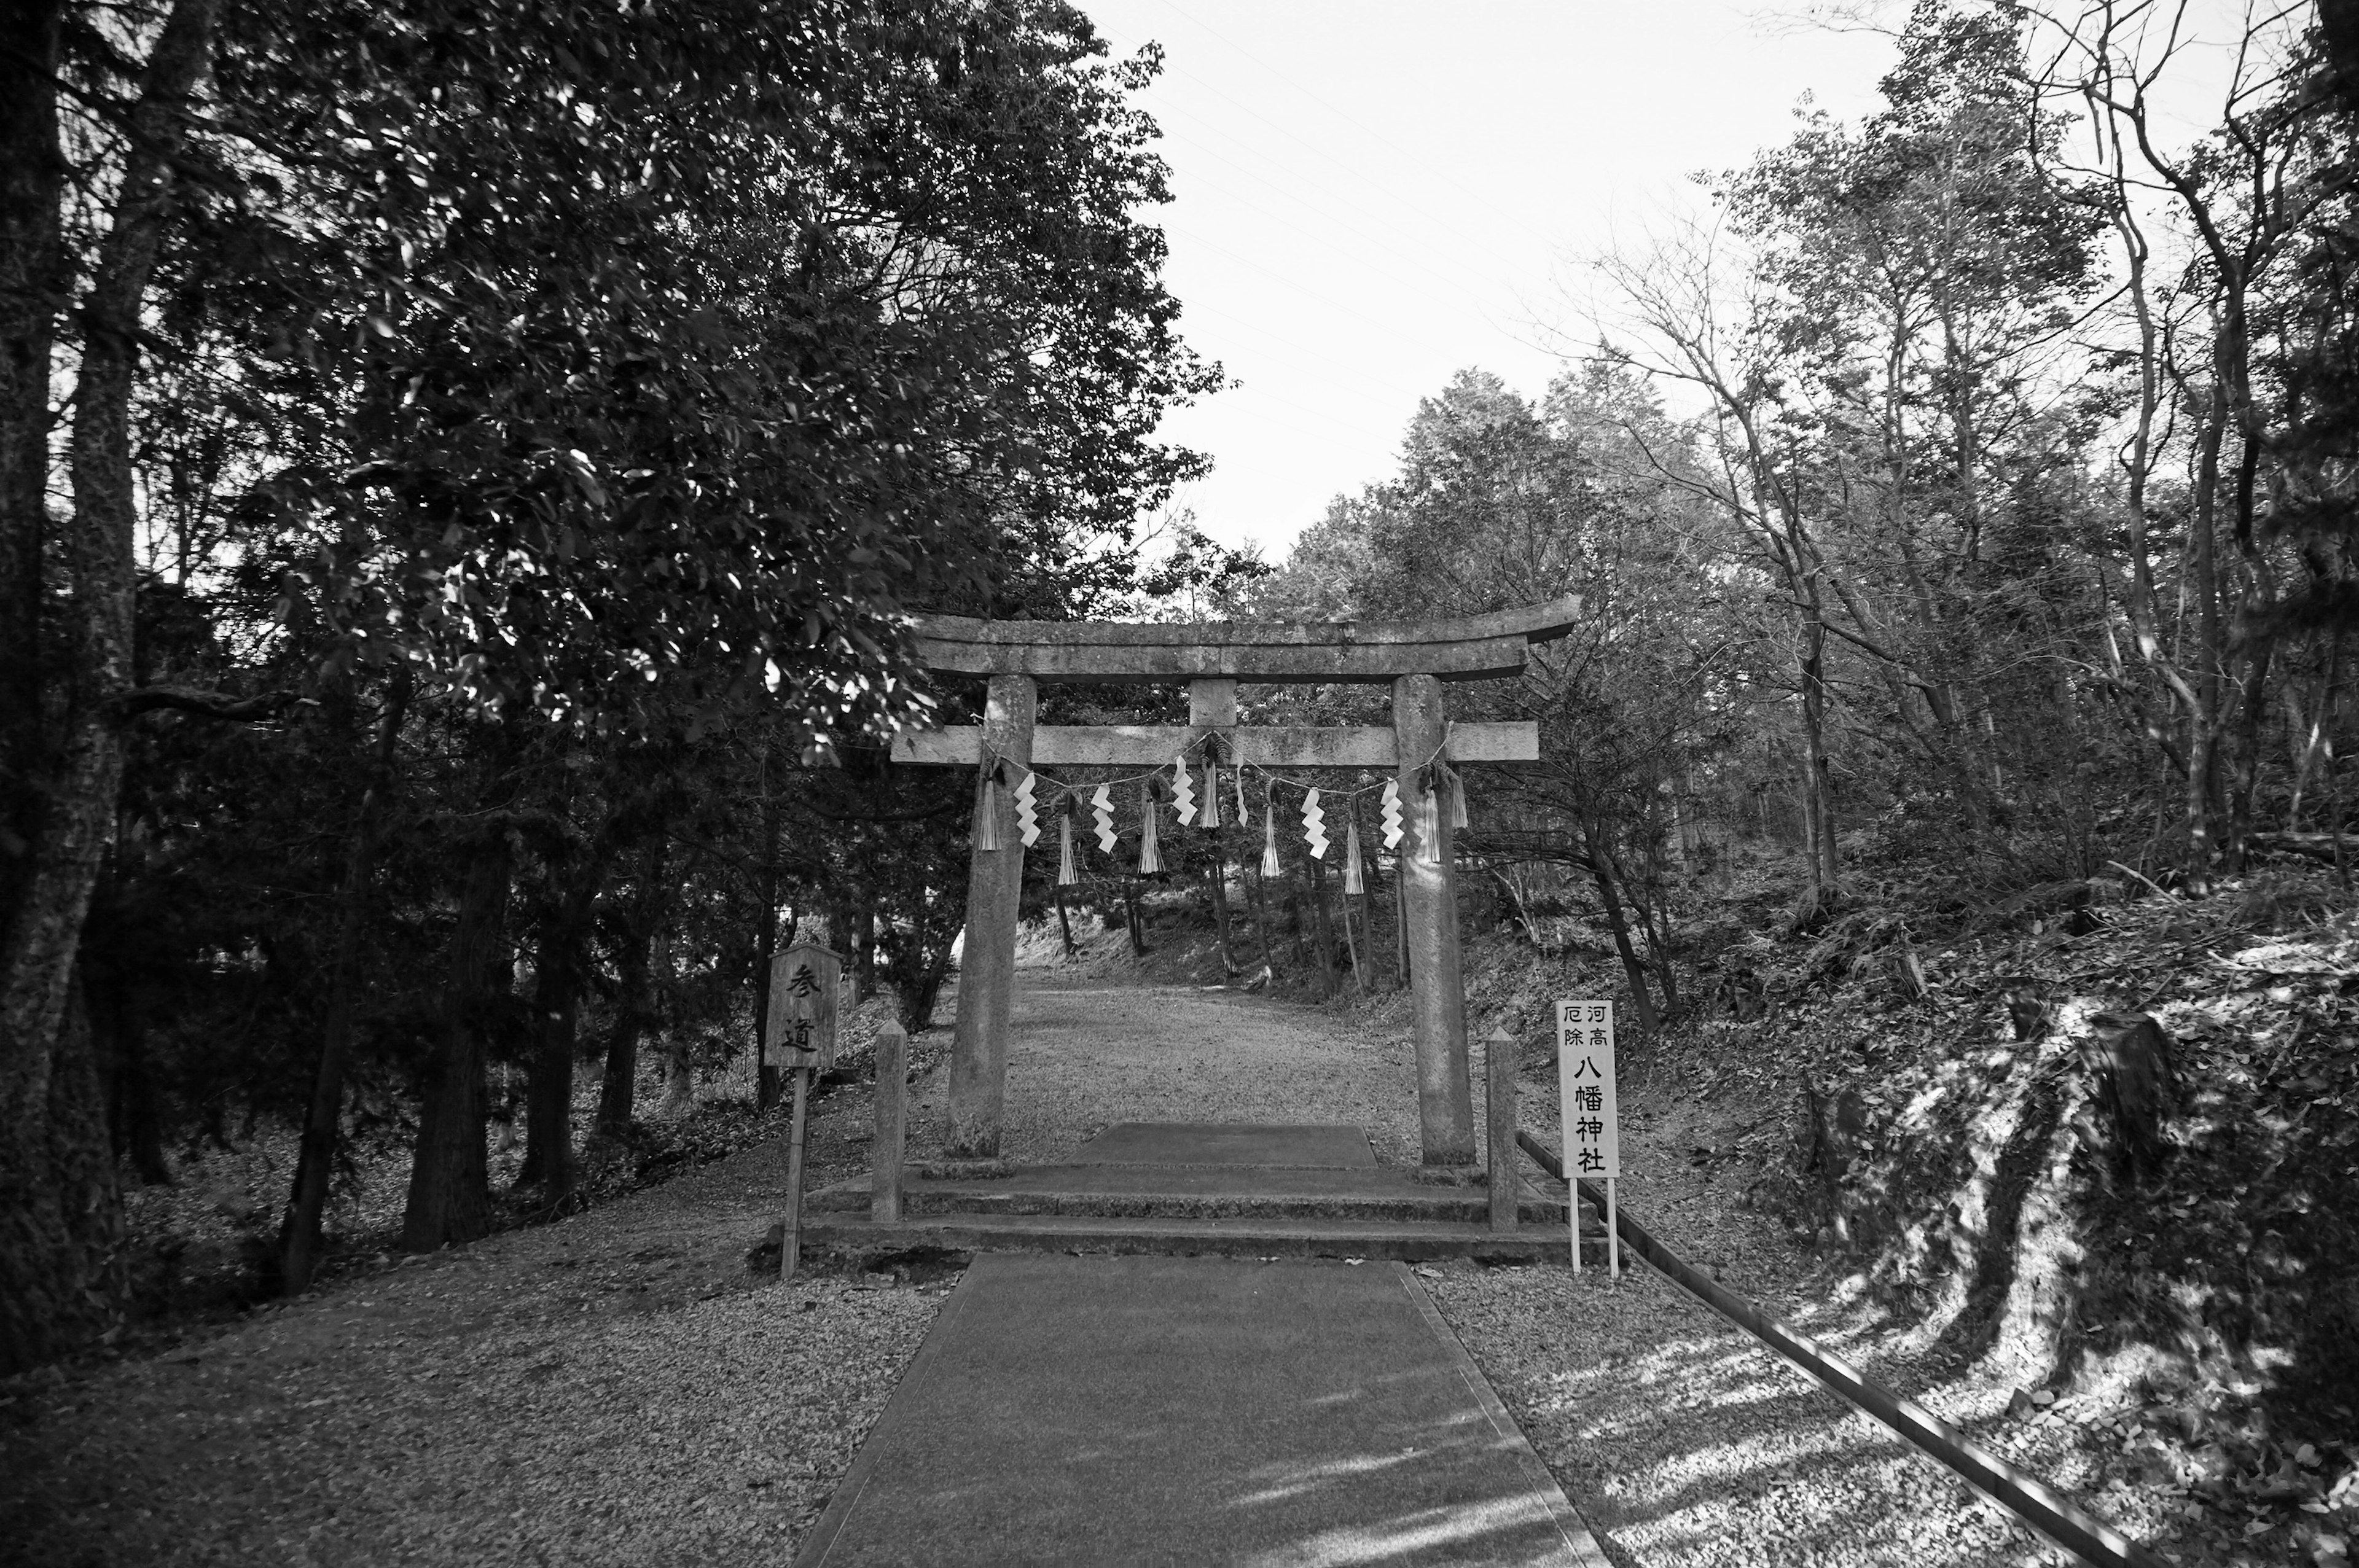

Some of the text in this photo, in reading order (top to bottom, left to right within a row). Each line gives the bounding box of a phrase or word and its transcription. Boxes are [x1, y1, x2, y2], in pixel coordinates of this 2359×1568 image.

[782, 964, 821, 1052] 参道
[1574, 1056, 1606, 1172] 八幡神社
